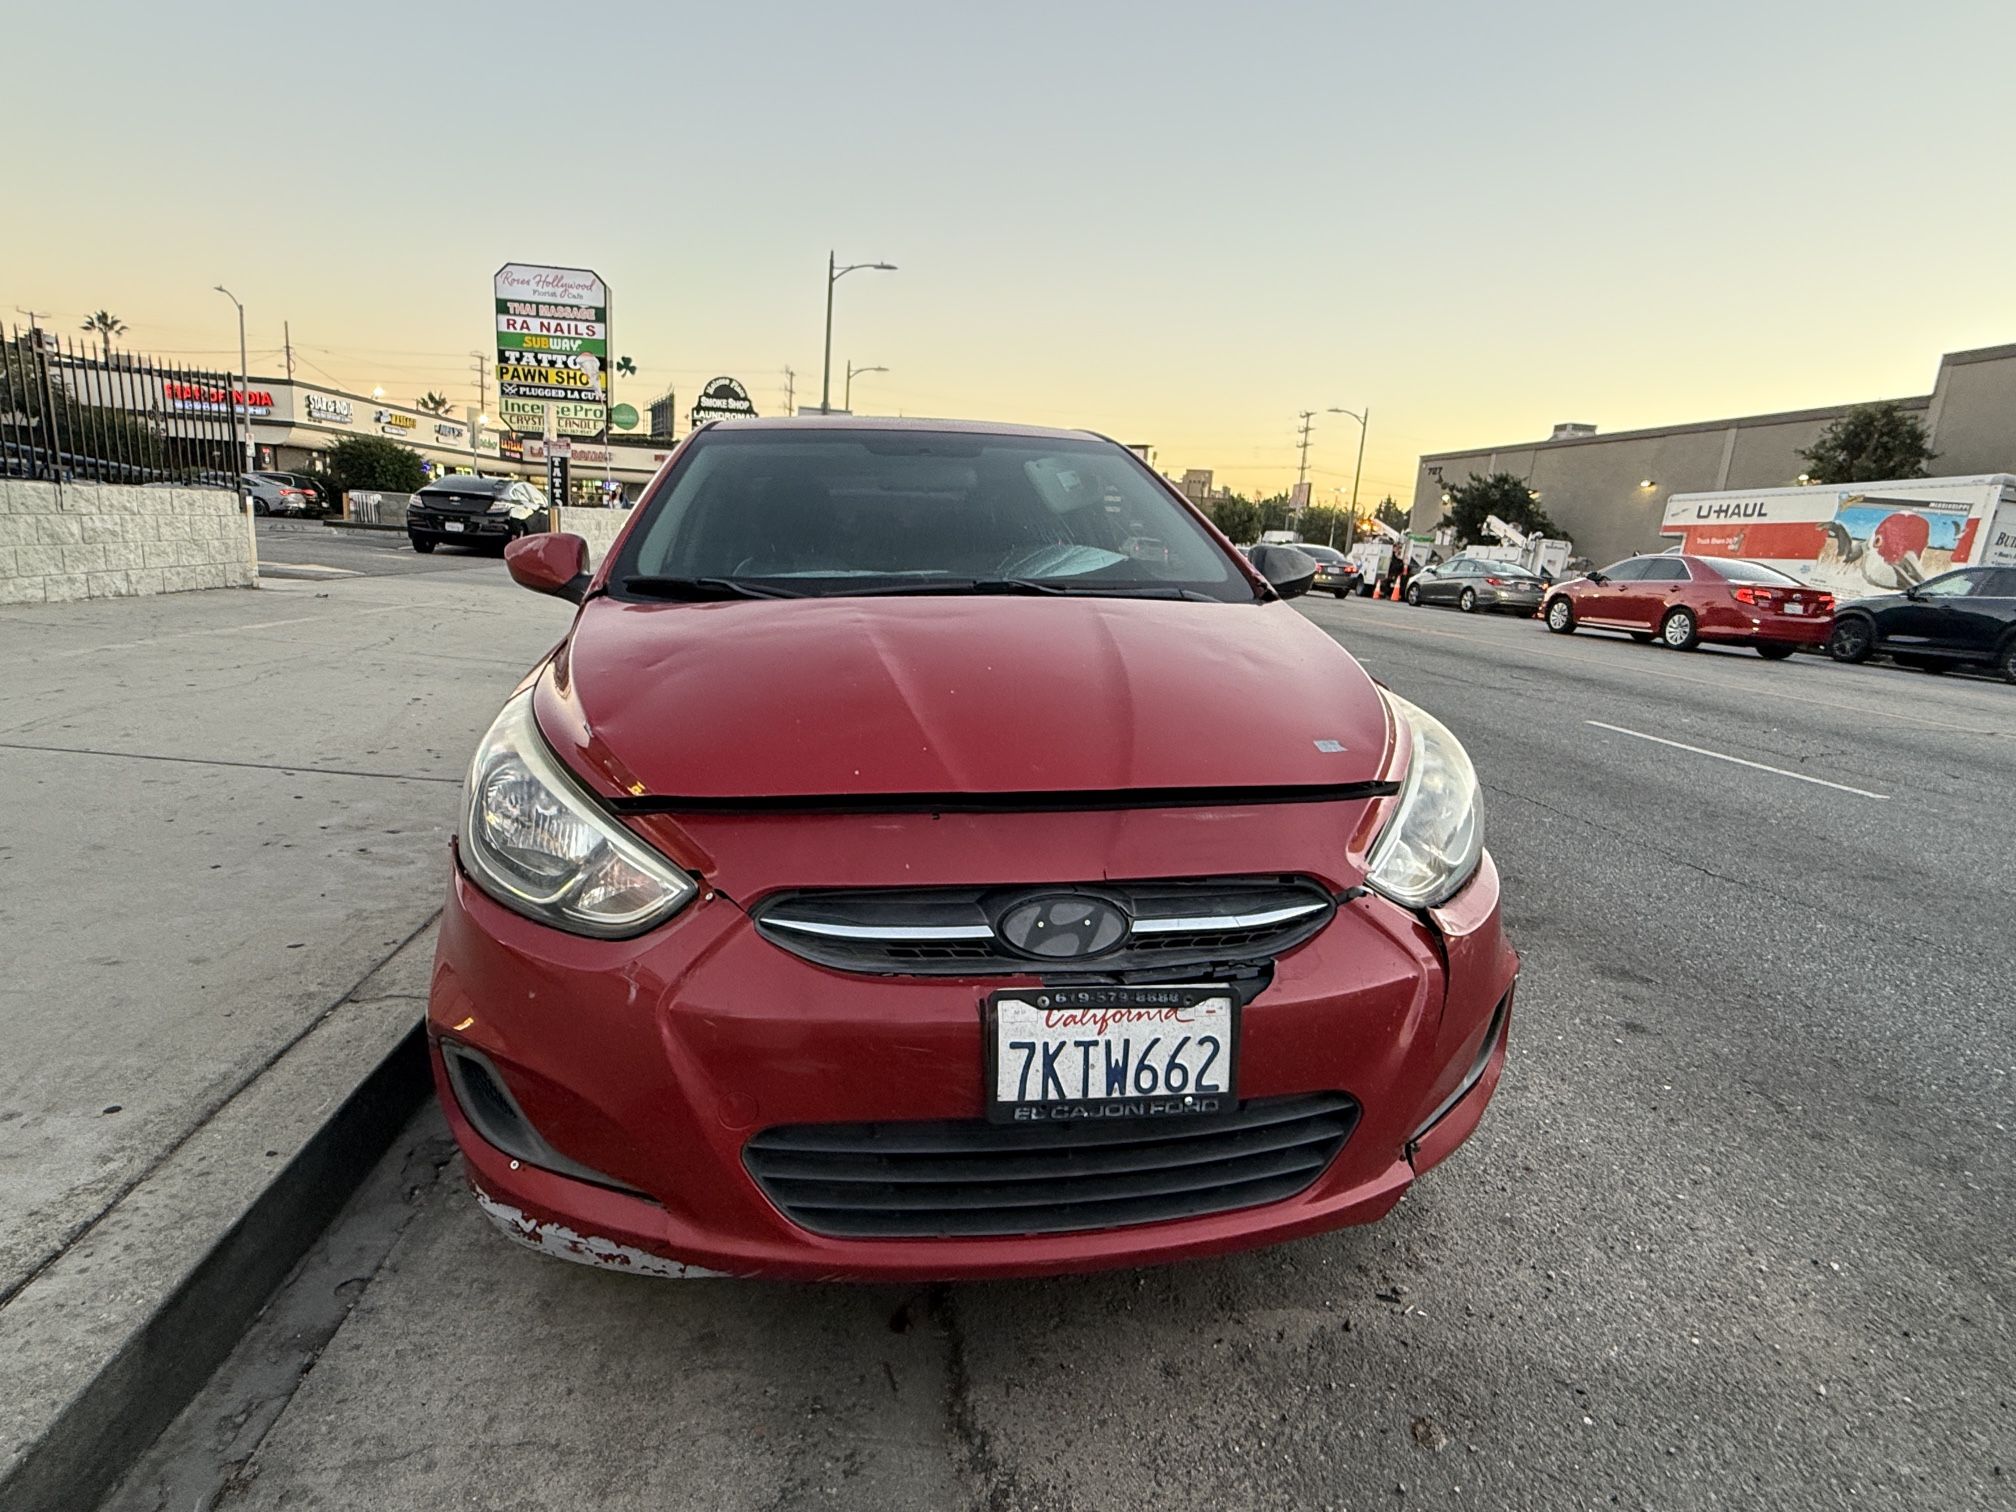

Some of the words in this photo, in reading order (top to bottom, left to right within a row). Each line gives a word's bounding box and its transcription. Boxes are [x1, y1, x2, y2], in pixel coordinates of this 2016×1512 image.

[533, 273, 596, 298] Hollywood
[507, 302, 537, 316] THAI
[538, 304, 596, 320] MASSAGE
[506, 318, 531, 332] RA
[540, 321, 596, 337] NAILS
[523, 336, 582, 351] SUBWAY
[500, 366, 549, 384] PAWN
[555, 370, 600, 387] SHO
[231, 388, 274, 407] NDIA
[519, 386, 566, 398] PLUGGED
[567, 390, 580, 399] LA
[574, 405, 604, 419] Pro
[700, 396, 728, 409] SMOKE
[728, 398, 750, 410] SHOP
[1696, 502, 1768, 520] U-HAUL
[1045, 1007, 1195, 1036] California
[1009, 1035, 1221, 1101] 7KTW662
[1014, 1105, 1046, 1121] EL
[1050, 1102, 1145, 1120] CAJON
[1149, 1099, 1220, 1115] FORD
